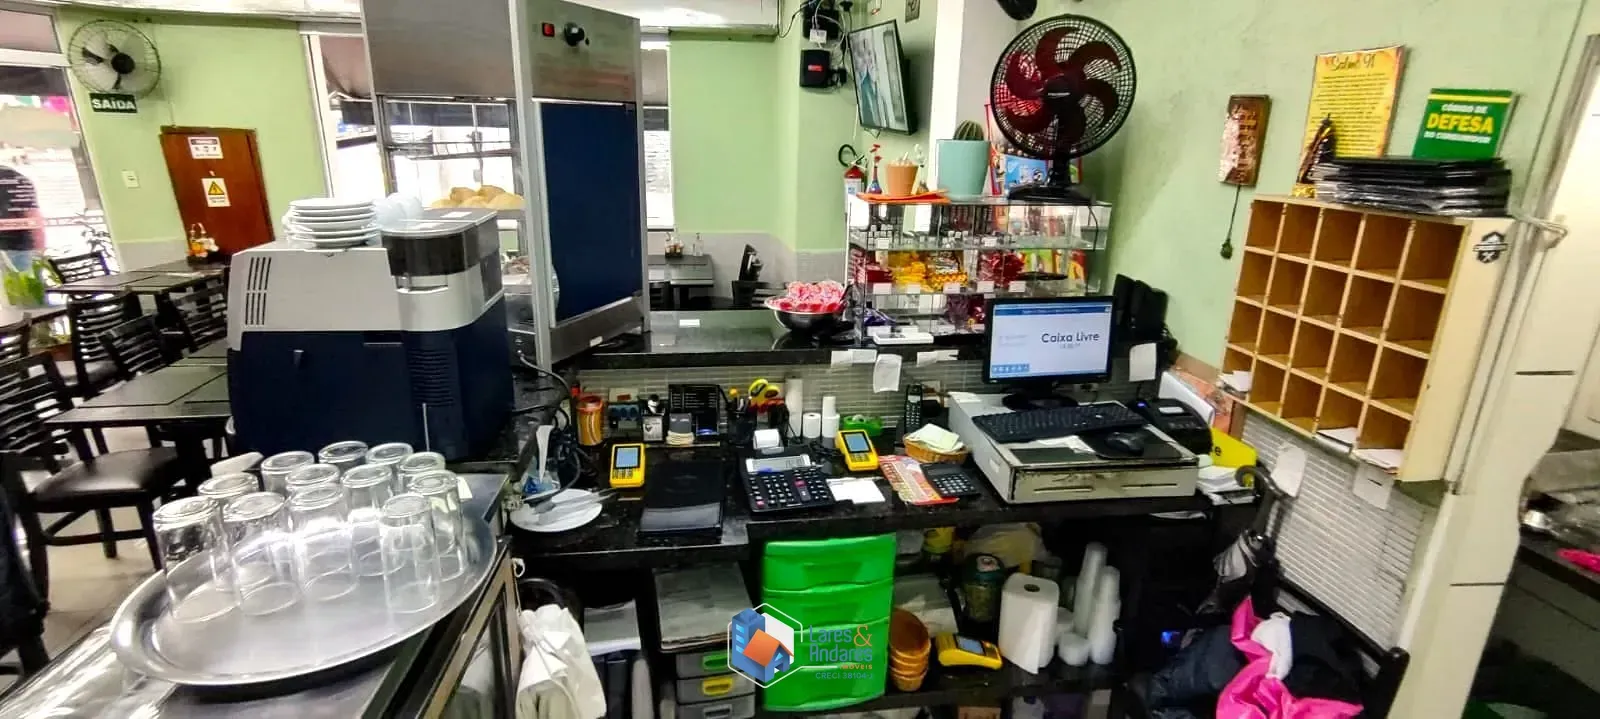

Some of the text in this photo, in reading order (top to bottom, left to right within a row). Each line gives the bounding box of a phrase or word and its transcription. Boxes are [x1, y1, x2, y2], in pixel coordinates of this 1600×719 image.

[1427, 112, 1494, 134] DEFESA
[1041, 332, 1073, 343] Caixa
[1076, 331, 1100, 342] Livre
